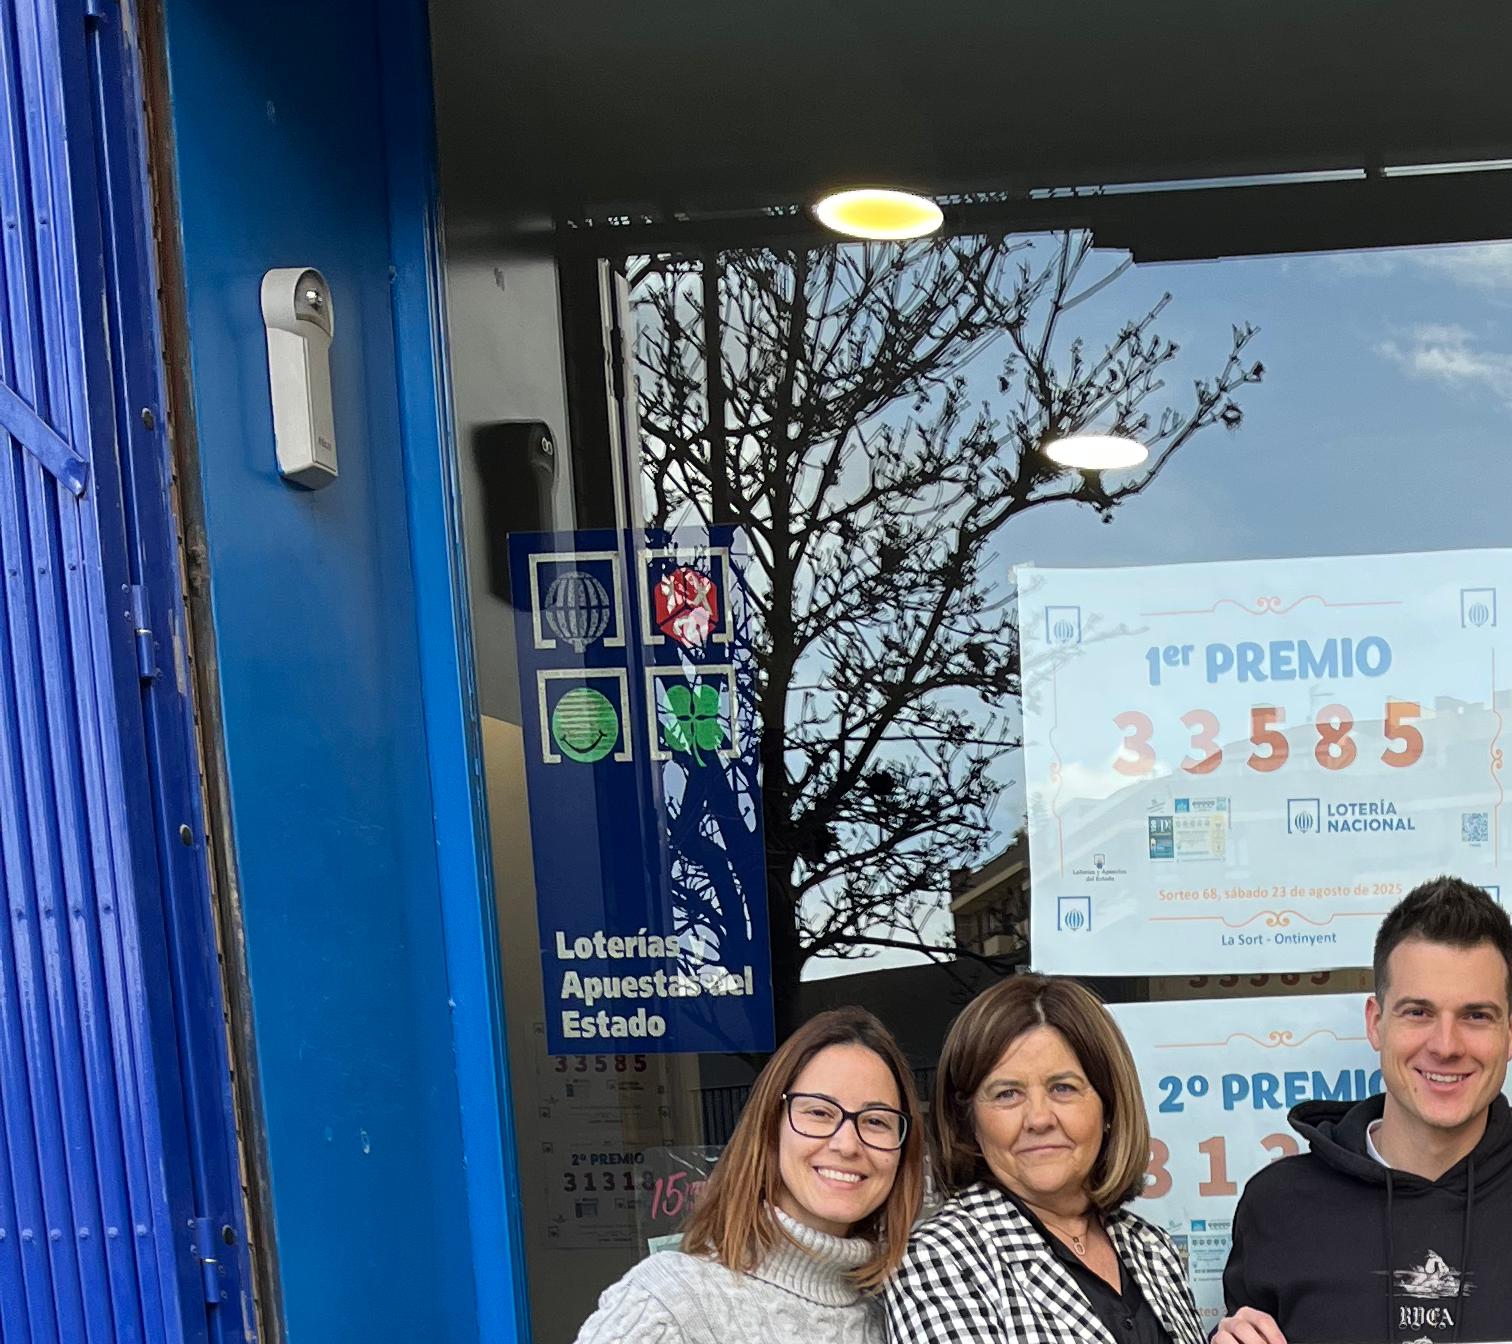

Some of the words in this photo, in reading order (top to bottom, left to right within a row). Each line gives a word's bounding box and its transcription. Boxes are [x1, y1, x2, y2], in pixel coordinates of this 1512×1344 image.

[1145, 643, 1195, 686] 1er
[1206, 636, 1392, 683] PREMIO
[1327, 799, 1397, 817] LOTERÍA
[1327, 817, 1416, 833] NACIONAL
[1159, 888, 1200, 901] Sorteo
[1202, 887, 1222, 902] 68,
[1224, 886, 1268, 899] sábado
[1272, 886, 1287, 898] 23
[1290, 885, 1306, 897] de
[1309, 884, 1350, 899] agosto
[1353, 883, 1369, 896] de
[1373, 883, 1402, 896] 2025
[555, 927, 681, 960] Loterías
[1222, 934, 1235, 946] La
[1238, 933, 1264, 946] Sort
[1274, 932, 1337, 947] Ontinyent
[561, 968, 701, 1006] Apuestas
[561, 1007, 667, 1039] Estado
[1158, 1075, 1209, 1114] 2º
[590, 1152, 645, 1166] PREMIO
